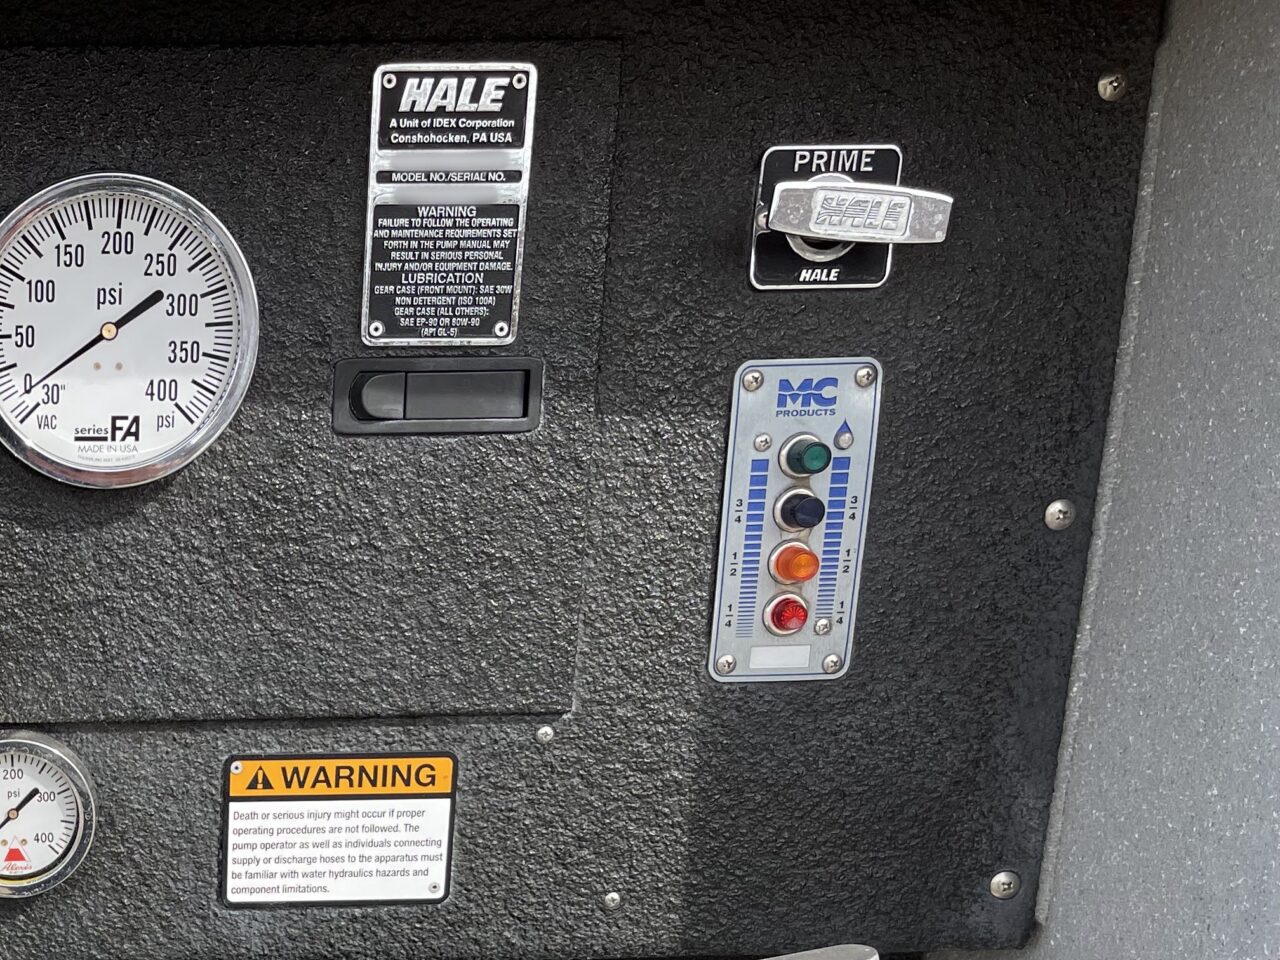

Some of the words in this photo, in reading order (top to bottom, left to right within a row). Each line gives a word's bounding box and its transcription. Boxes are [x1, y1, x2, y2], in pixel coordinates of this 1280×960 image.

[399, 78, 510, 112] HALE
[389, 119, 397, 128] A
[400, 119, 419, 128] Unit
[421, 119, 431, 128] of
[433, 119, 456, 128] IDEX
[459, 118, 514, 129] Corporation
[391, 133, 469, 144] Conshohocken,
[472, 133, 487, 142] PA
[490, 133, 512, 142] USA
[794, 151, 875, 172] PRIME
[392, 172, 427, 182] MODEL
[430, 172, 486, 182] NO./SERIAL
[489, 172, 506, 181] NO.
[418, 206, 476, 217] WARNING
[378, 218, 409, 227] FAILURE
[411, 218, 420, 227] TO
[423, 218, 454, 227] FOLLOW
[456, 218, 469, 227] THE
[472, 218, 513, 226] OPERATING
[101, 232, 134, 254] 200
[55, 244, 84, 267] 150
[391, 252, 419, 260] RESULT
[421, 252, 429, 260] IN
[431, 251, 462, 260] SERIOUS
[465, 251, 503, 260] PERSONAL
[144, 253, 176, 276] 250
[402, 273, 483, 284] LUBRICATION
[799, 269, 840, 281] HALE
[26, 280, 55, 303] 100
[97, 283, 122, 309] psi
[166, 294, 198, 316] 300
[15, 325, 34, 347] 50
[168, 341, 200, 363] 350
[146, 379, 177, 401] 400
[777, 377, 838, 408] MC
[776, 408, 836, 417] PRODUCTS
[37, 415, 57, 429] VAC
[157, 411, 175, 431] psi
[74, 426, 109, 435] series
[111, 416, 140, 442] FA
[3, 769, 23, 780] 200
[281, 764, 436, 789] WARNING
[8, 788, 20, 799] psi
[233, 811, 258, 820] Death
[273, 811, 304, 820] serious
[307, 810, 331, 821] injury
[334, 810, 359, 820] might
[389, 809, 394, 818] if
[397, 810, 425, 820] proper
[233, 825, 274, 836] operating
[277, 825, 326, 835] procedures
[329, 826, 342, 834] are
[345, 825, 359, 833] not
[362, 824, 401, 833] followed.
[404, 824, 419, 833] The
[34, 833, 54, 843] 400
[232, 841, 257, 852] pump
[260, 840, 297, 851] operator
[312, 839, 329, 848] well
[345, 839, 391, 848] individuals
[394, 838, 442, 849] connecting
